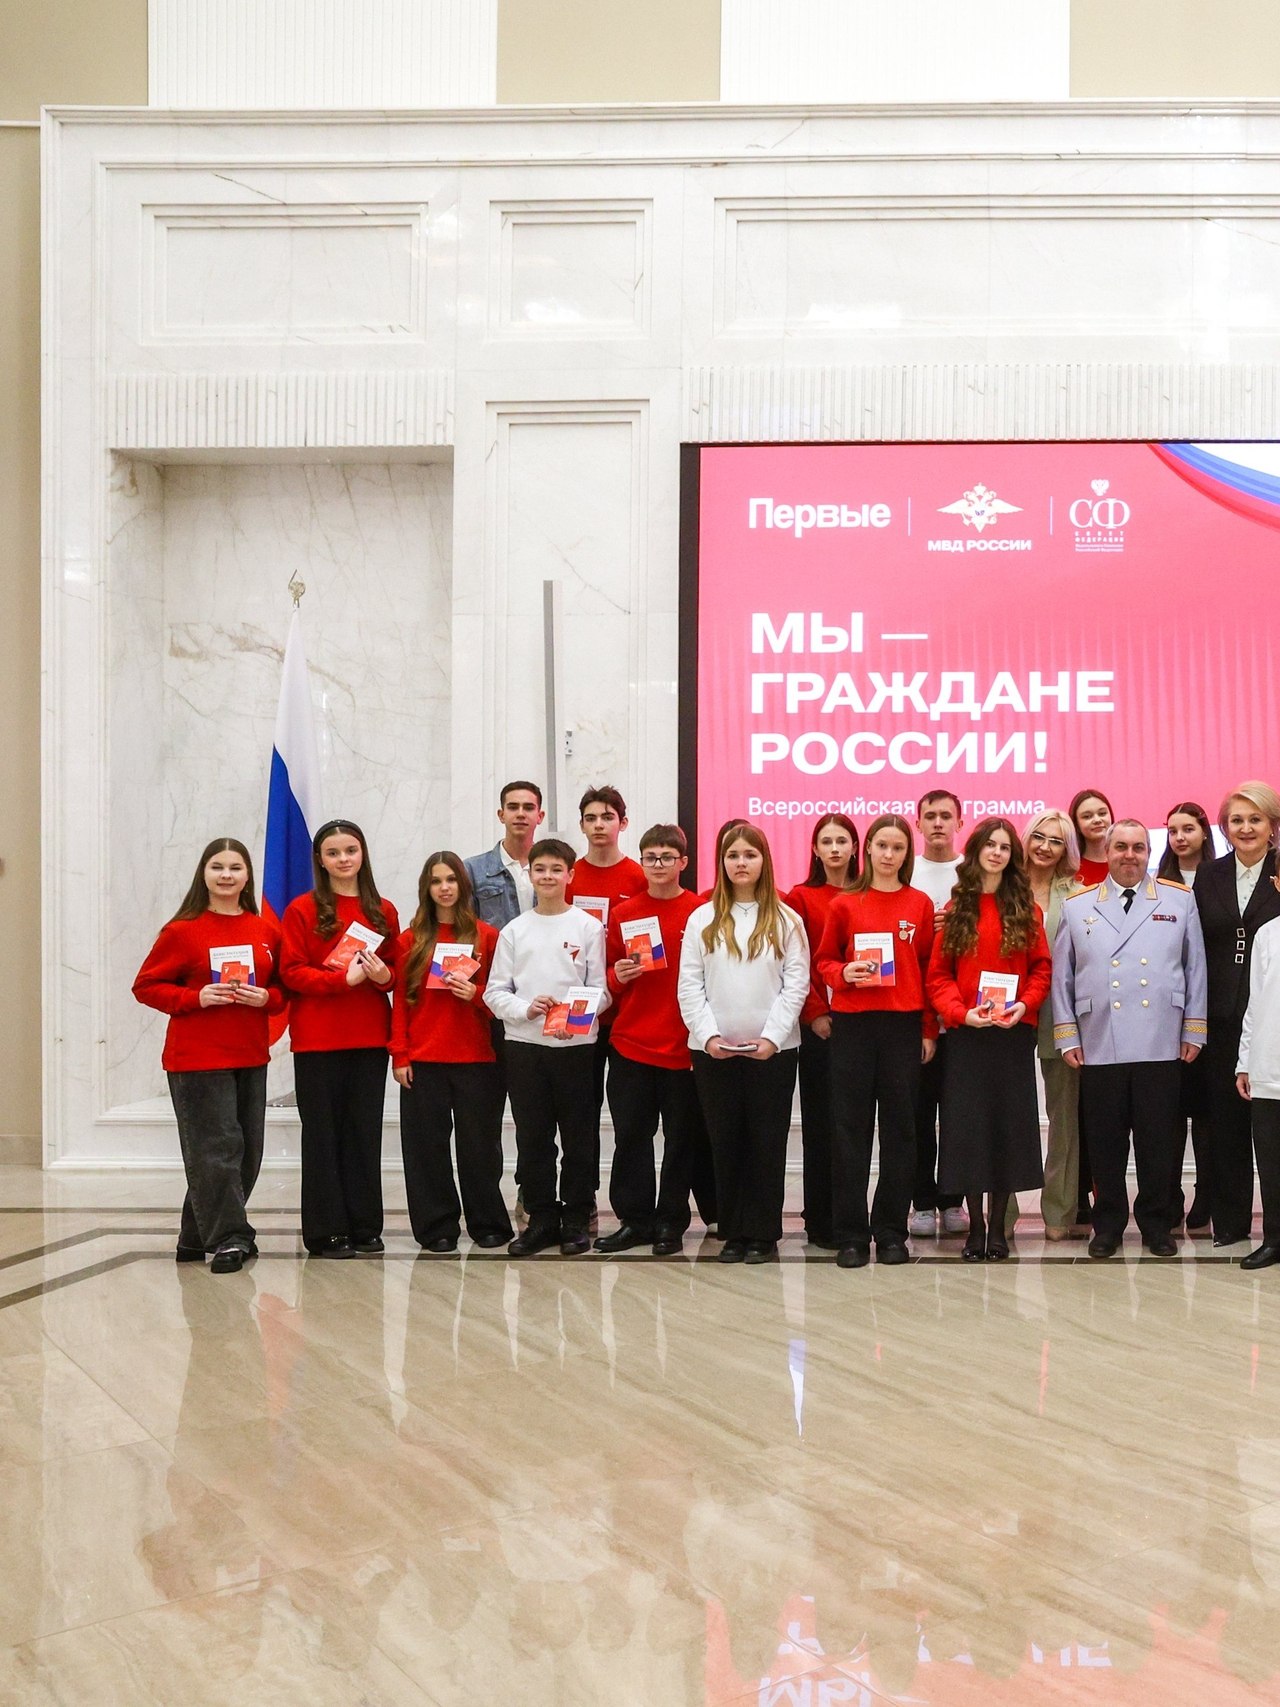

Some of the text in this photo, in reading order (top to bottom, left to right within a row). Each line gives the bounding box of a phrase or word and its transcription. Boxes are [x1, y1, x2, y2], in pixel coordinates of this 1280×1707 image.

[749, 498, 892, 538] Первые
[1069, 498, 1131, 529] СФ
[927, 540, 1032, 552] МВД РОССИИ
[751, 612, 864, 654] МЫ
[751, 671, 1115, 721] ГРАЖДАНЕ
[751, 731, 1047, 775] РОССИИ!
[748, 797, 1046, 820] Всероссийская грамма
